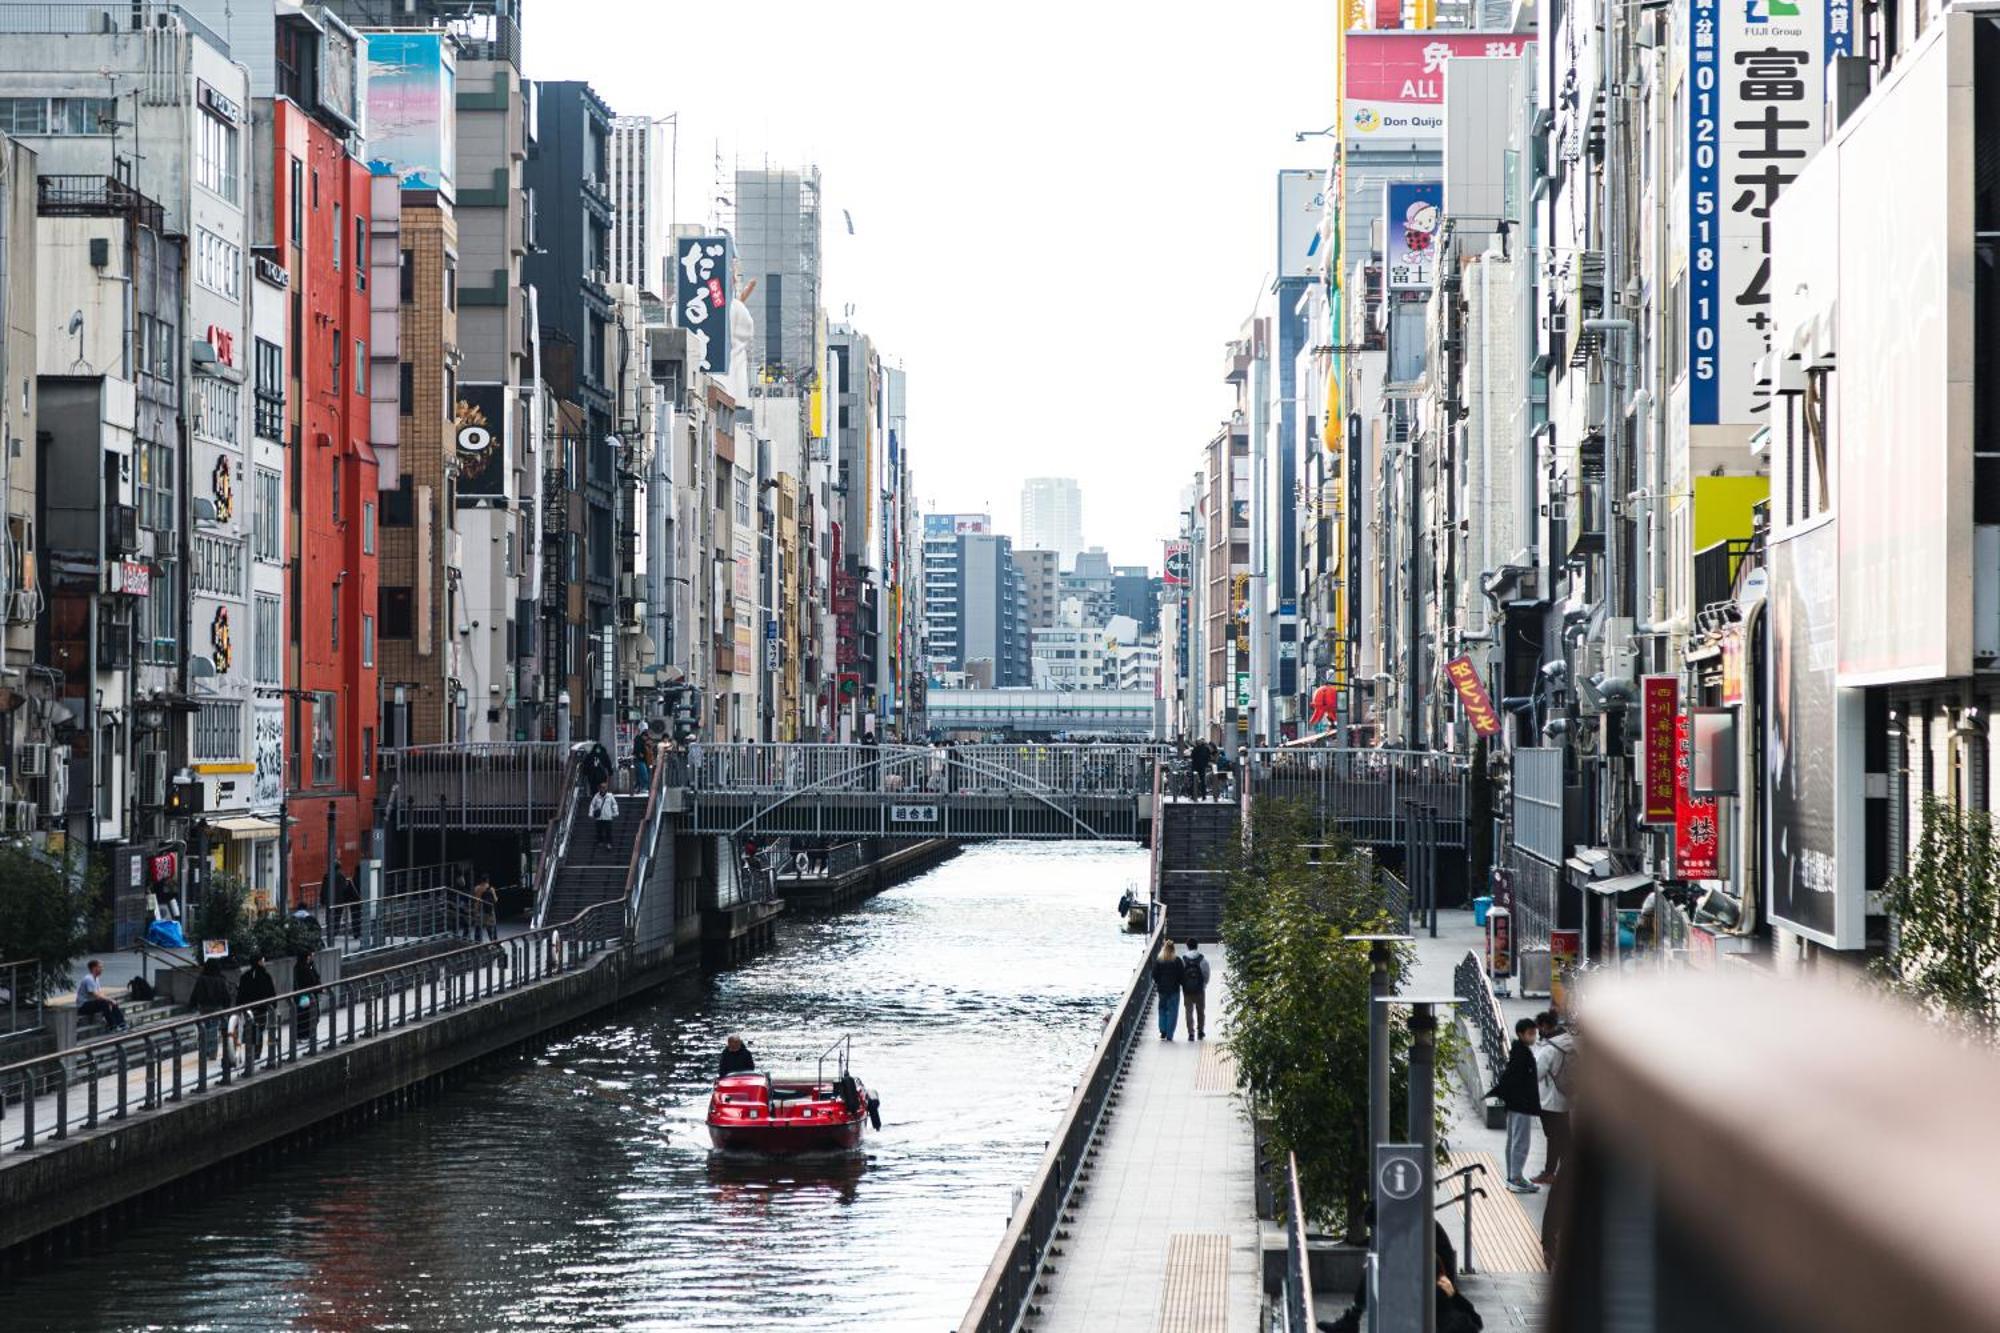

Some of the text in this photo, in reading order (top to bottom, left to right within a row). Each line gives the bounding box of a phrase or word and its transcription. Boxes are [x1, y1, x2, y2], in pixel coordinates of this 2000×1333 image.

[1745, 27, 1803, 37] FUJI Group
[1400, 79, 1438, 99] ALL
[1383, 117, 1408, 127] Don
